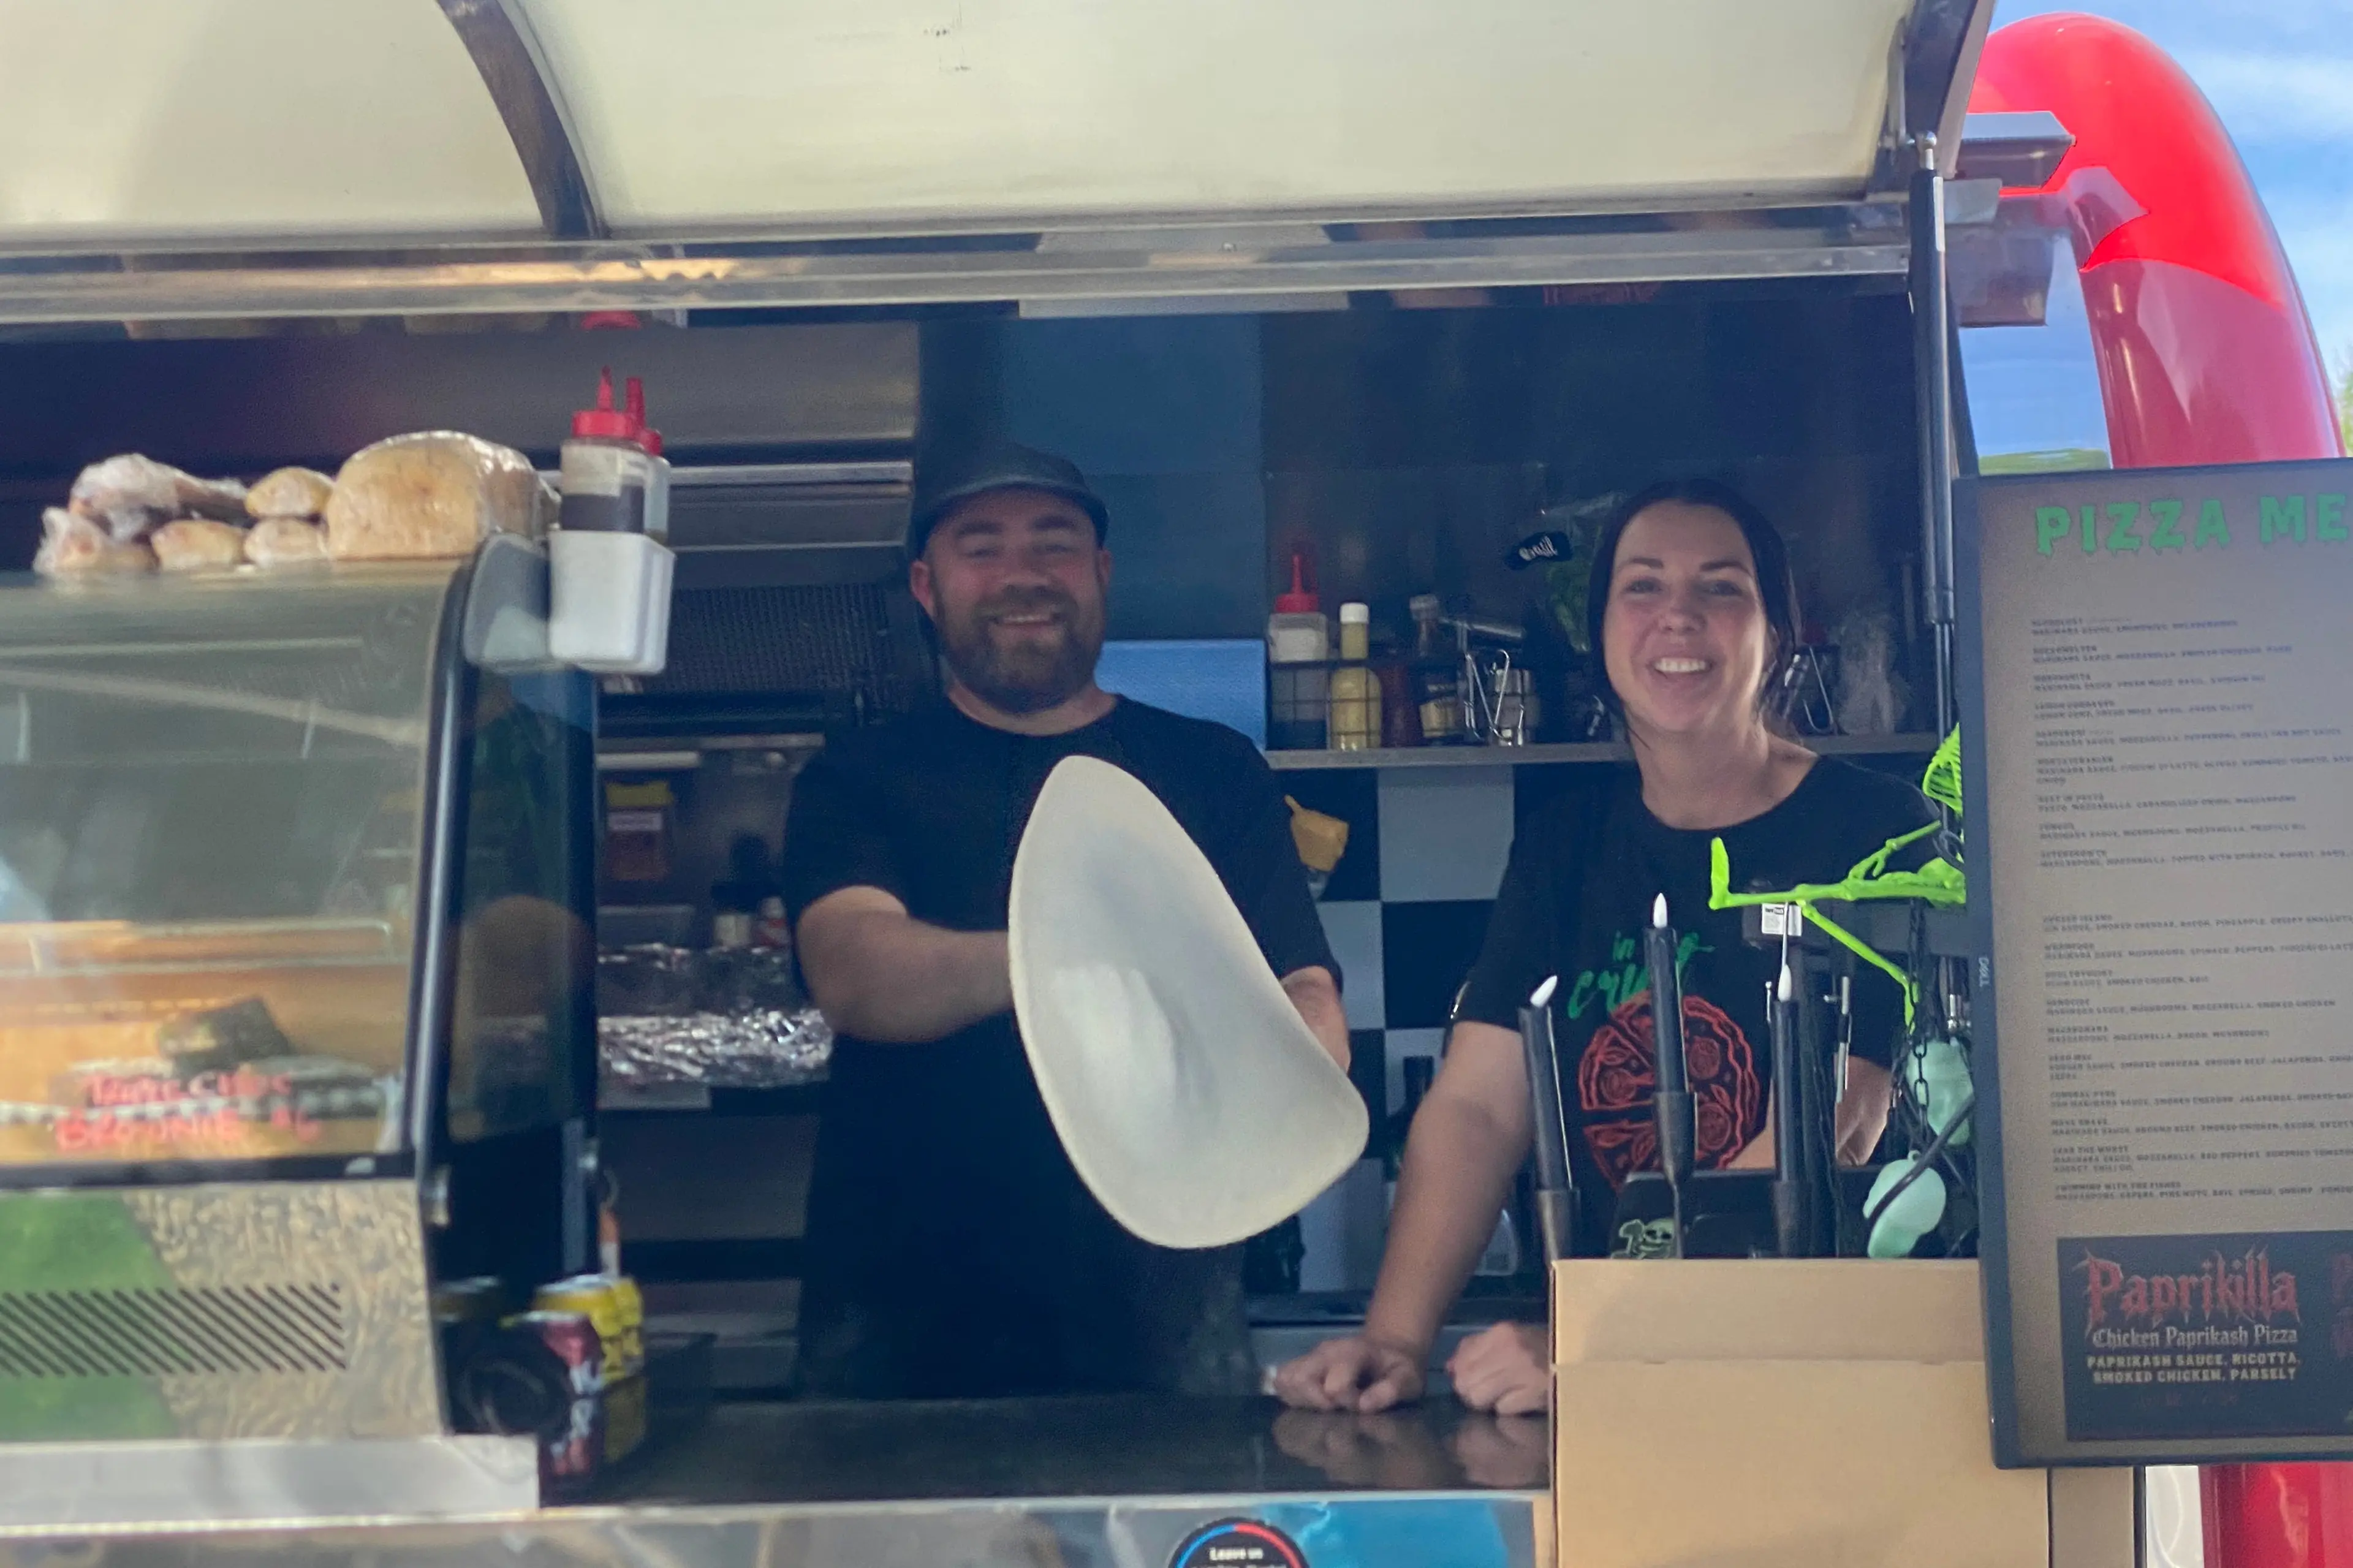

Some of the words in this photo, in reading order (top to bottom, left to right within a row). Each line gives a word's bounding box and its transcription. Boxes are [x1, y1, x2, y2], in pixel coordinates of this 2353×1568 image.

[2036, 499, 2230, 556] PIZZA
[2074, 1245, 2302, 1336] Paprikilla
[2092, 1328, 2159, 1348] Chicken
[2165, 1326, 2248, 1349] Paprikash
[2254, 1324, 2297, 1345] Pizza
[2087, 1354, 2172, 1368] PAPRIKASH
[2093, 1371, 2153, 1384] SMOKED
